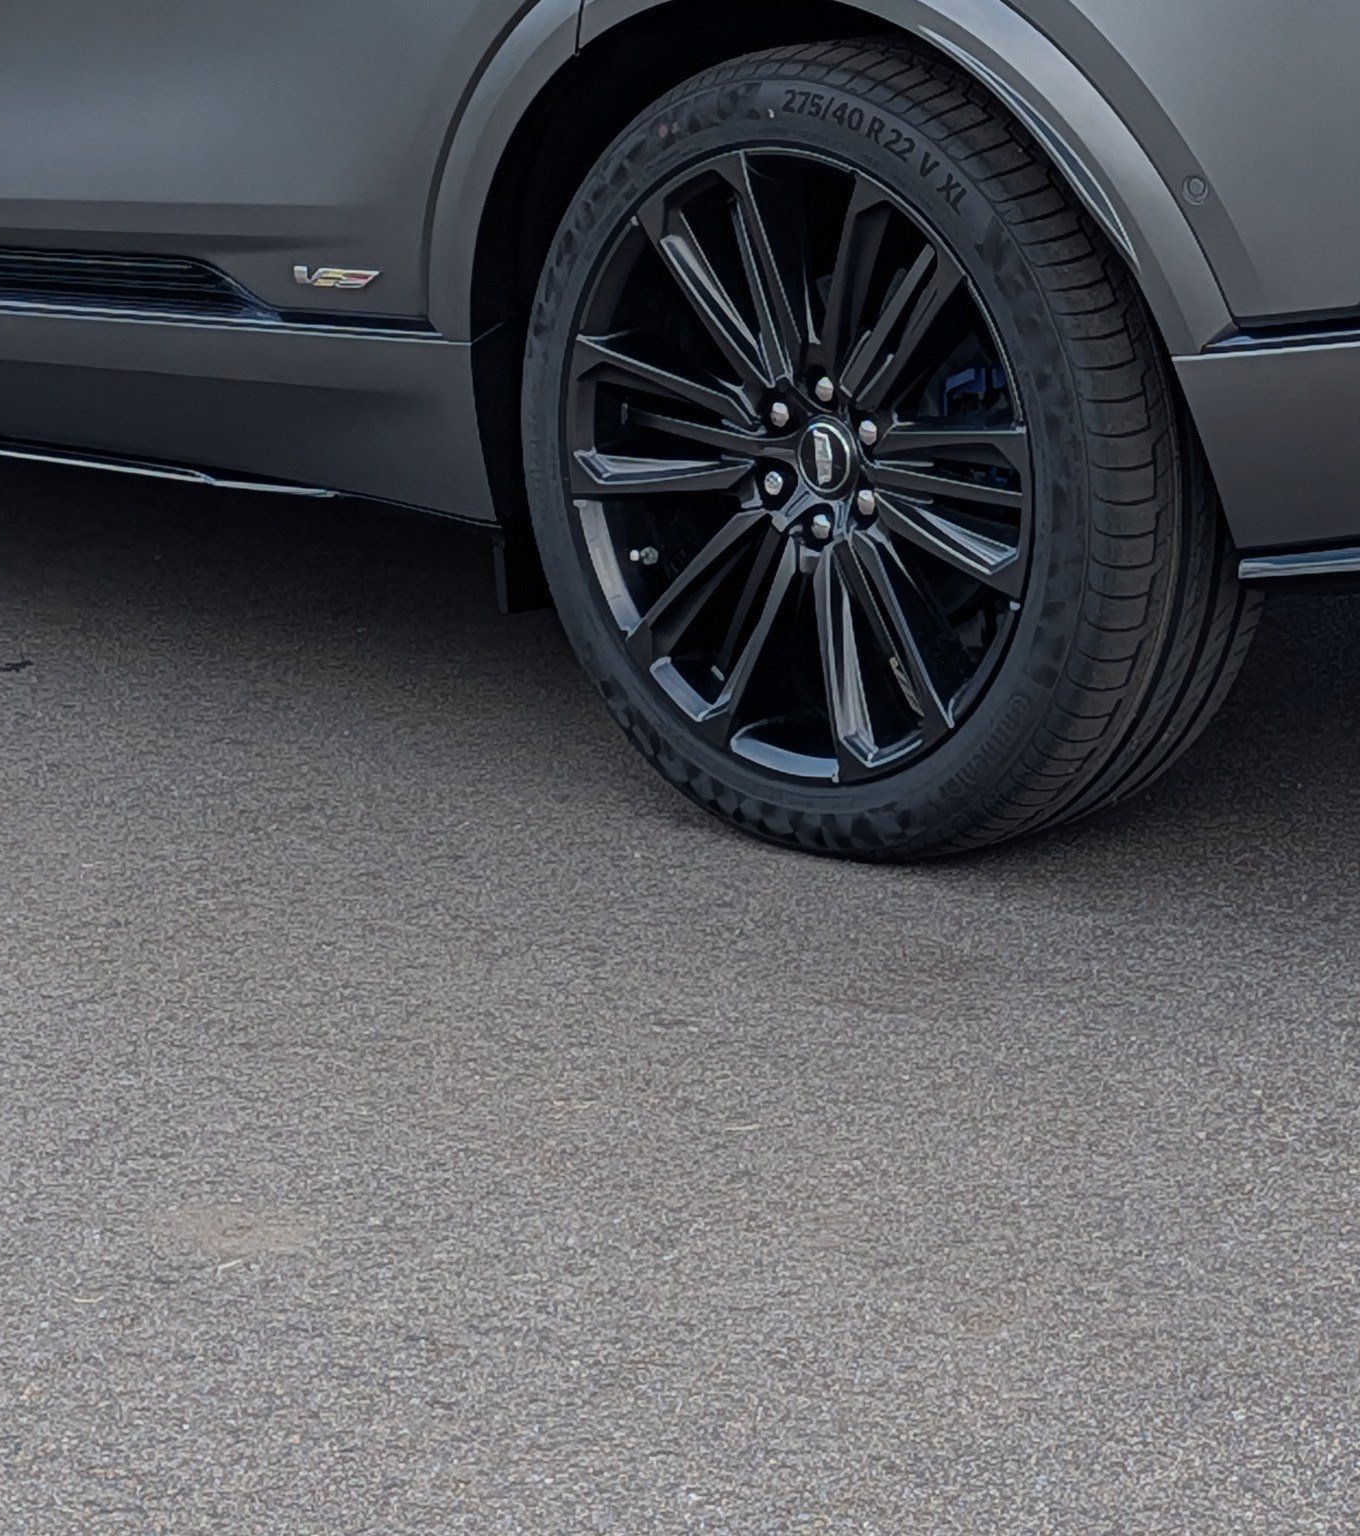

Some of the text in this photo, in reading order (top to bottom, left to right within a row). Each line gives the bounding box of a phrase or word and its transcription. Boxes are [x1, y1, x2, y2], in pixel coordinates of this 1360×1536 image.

[781, 88, 968, 216] 275/40 R 22 V XL
